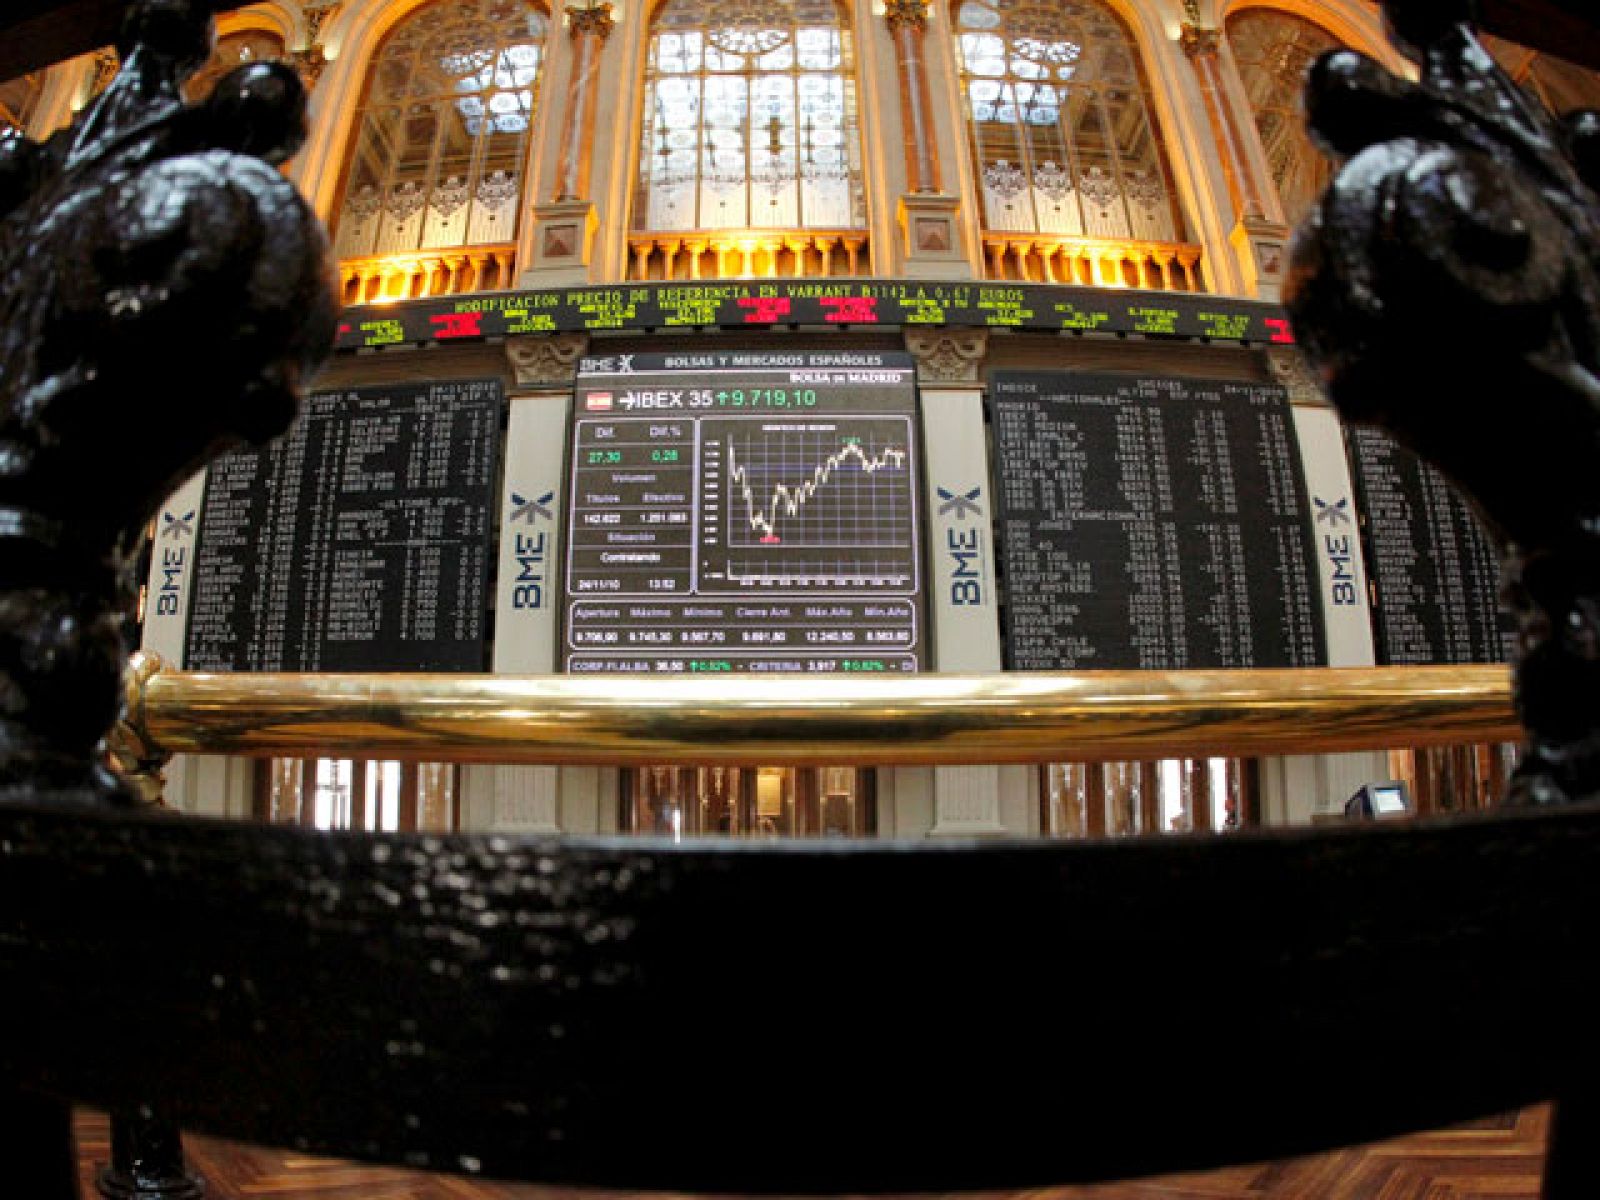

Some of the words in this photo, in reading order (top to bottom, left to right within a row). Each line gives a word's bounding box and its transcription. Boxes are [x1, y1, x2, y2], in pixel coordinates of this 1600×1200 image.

[759, 285, 779, 298] EN
[664, 357, 714, 368] BOLSAS
[719, 357, 728, 366] Y
[732, 355, 804, 367] MERCADOS
[809, 352, 883, 366] ESPAÑOLES
[848, 372, 902, 383] MADRID
[634, 390, 683, 409] IBEX
[688, 390, 714, 407] 35
[731, 389, 817, 408] 9.719,10
[156, 546, 186, 616] BME
[511, 531, 545, 610] BME
[946, 526, 981, 606] BME
[1324, 534, 1356, 606] BME
